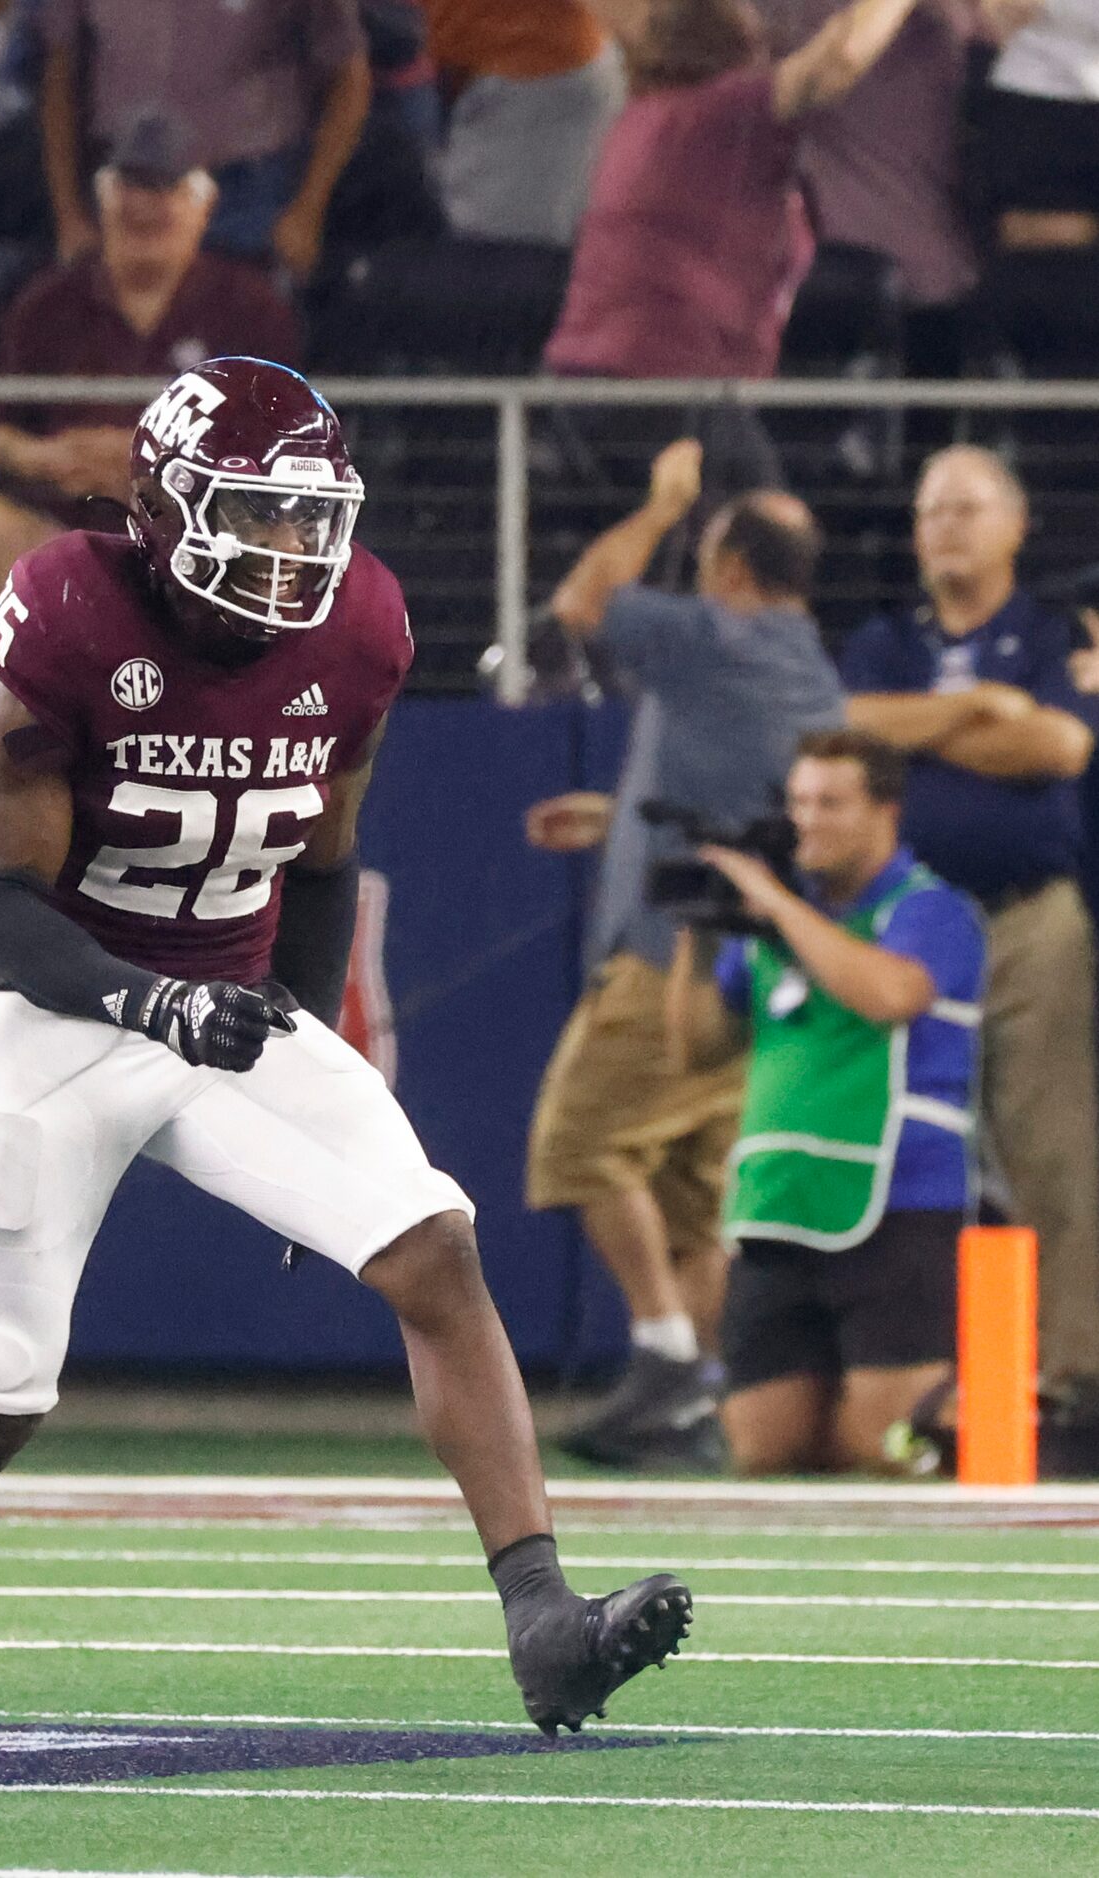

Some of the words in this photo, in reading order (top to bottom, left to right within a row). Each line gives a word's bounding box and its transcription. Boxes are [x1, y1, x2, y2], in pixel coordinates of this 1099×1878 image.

[289, 459, 324, 472] AGGIES
[115, 661, 160, 708] SEC
[281, 703, 329, 717] adidas
[105, 733, 254, 779] TEXAS
[261, 736, 338, 779] A&M
[77, 780, 324, 921] 26
